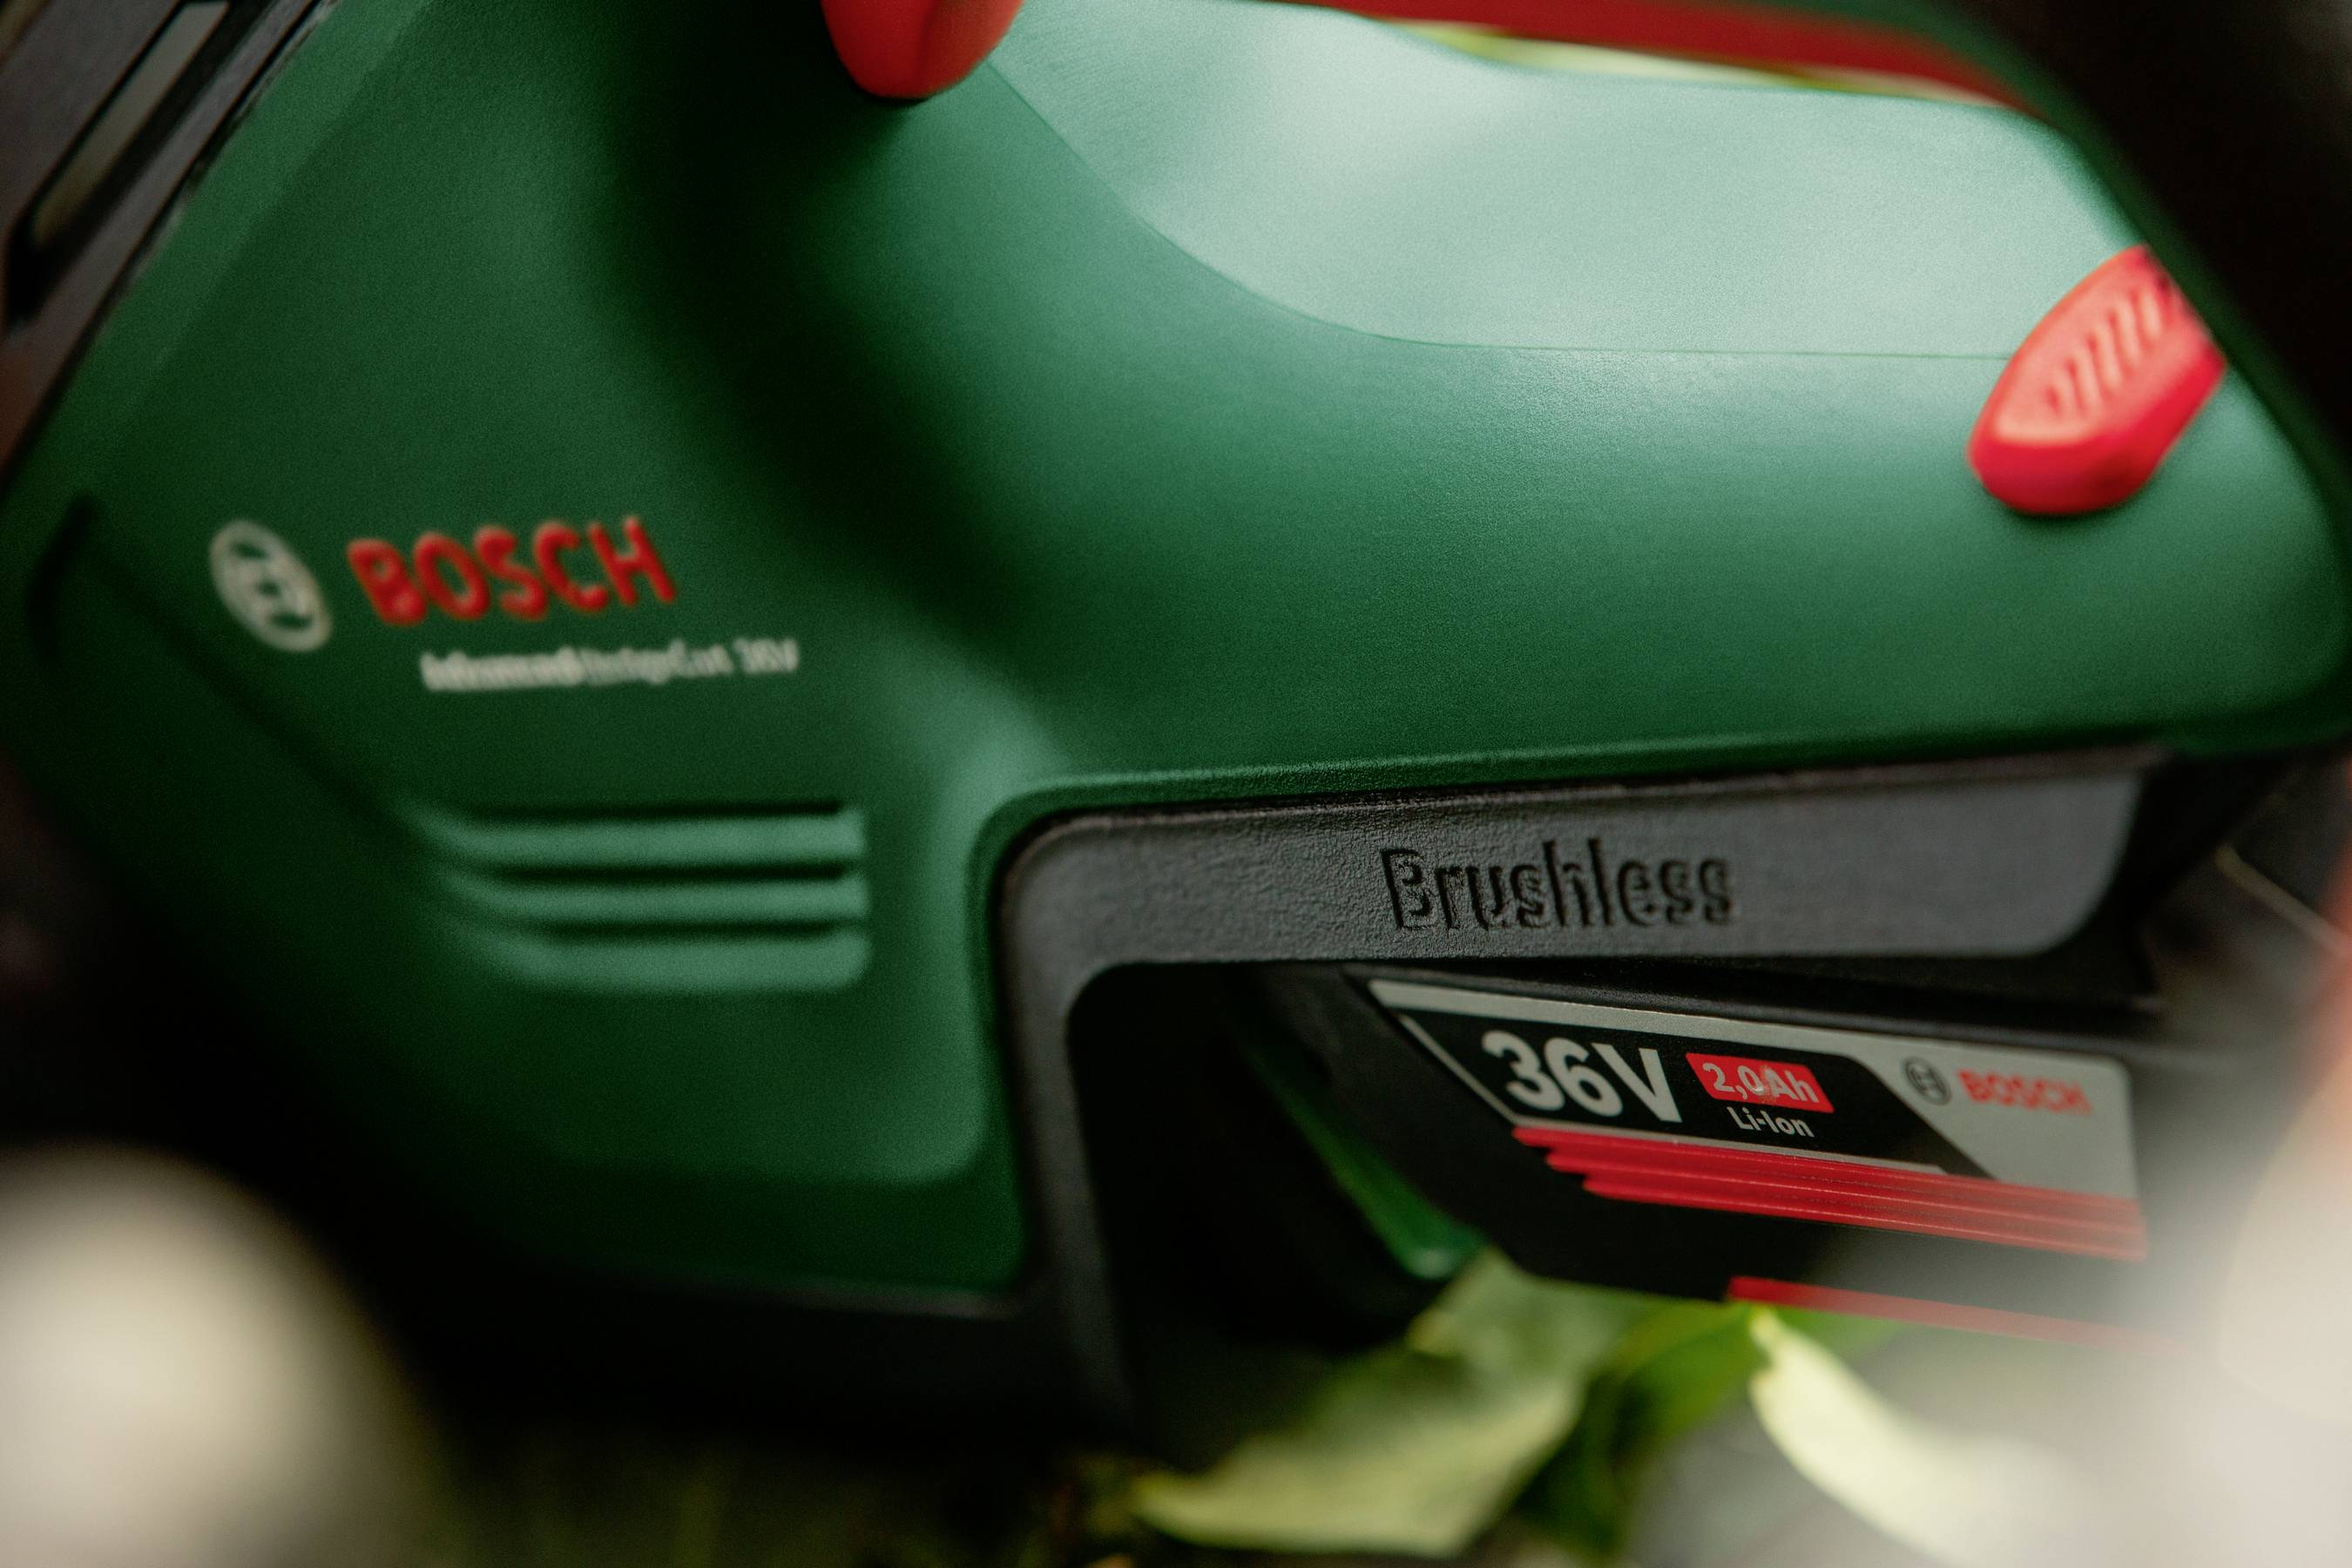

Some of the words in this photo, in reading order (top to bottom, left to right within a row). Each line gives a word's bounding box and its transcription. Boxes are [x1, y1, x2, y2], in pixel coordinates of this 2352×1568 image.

[348, 517, 676, 625] BOSCH
[1381, 837, 1732, 929] Brushless
[1482, 1030, 1682, 1123] 36V
[1702, 1062, 1819, 1103] 2,0Ah
[1727, 1106, 1815, 1138] Li-Ion
